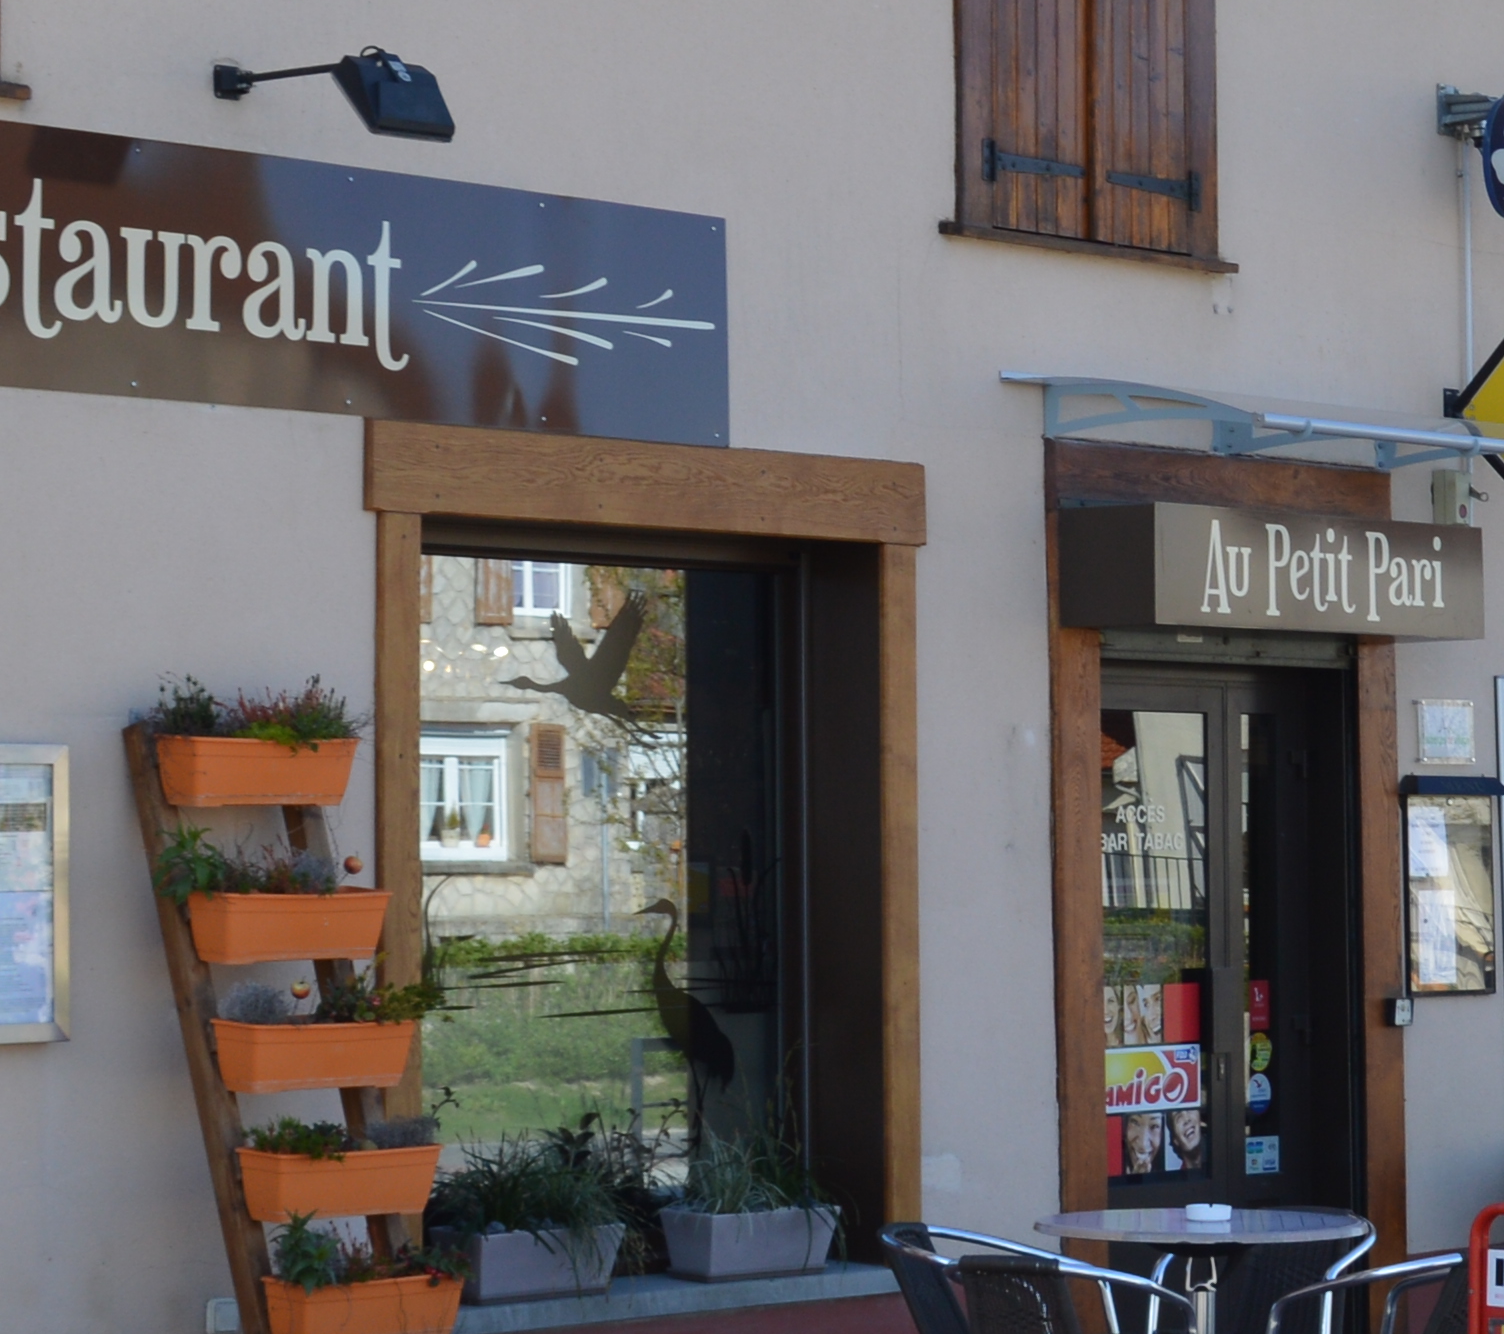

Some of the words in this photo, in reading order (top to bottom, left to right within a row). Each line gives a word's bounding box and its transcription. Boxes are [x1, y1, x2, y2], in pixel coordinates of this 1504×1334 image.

[1200, 519, 1252, 613] Au
[1265, 523, 1356, 617] Petit
[1365, 531, 1445, 621] Pari
[1135, 832, 1185, 851] TABAC
